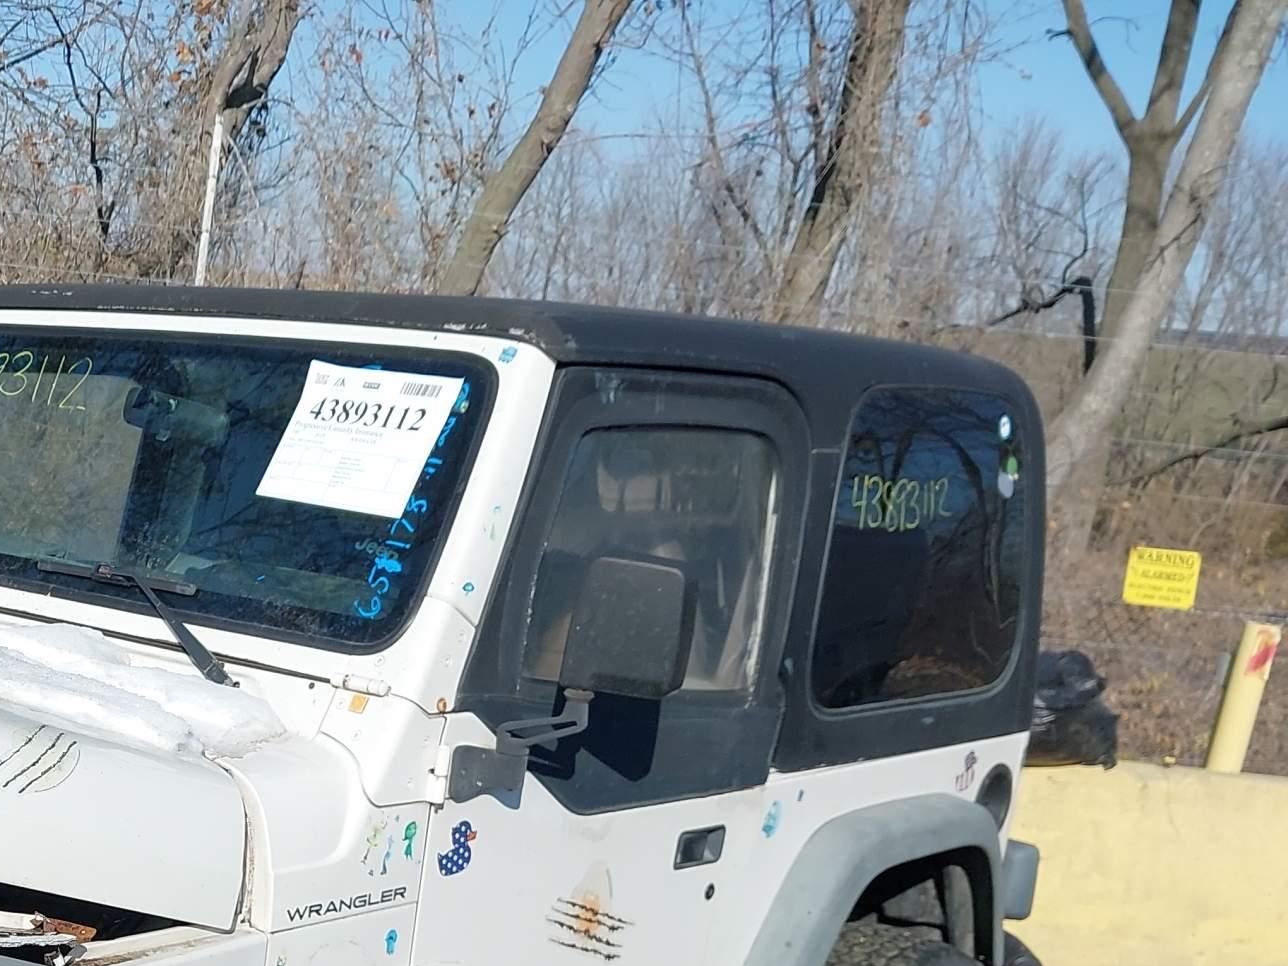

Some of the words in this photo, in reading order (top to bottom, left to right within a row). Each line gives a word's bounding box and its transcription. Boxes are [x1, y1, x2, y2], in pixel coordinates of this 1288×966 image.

[309, 397, 426, 431] 43893112
[852, 474, 952, 533] 43893112
[287, 886, 407, 922] WRANGLER
